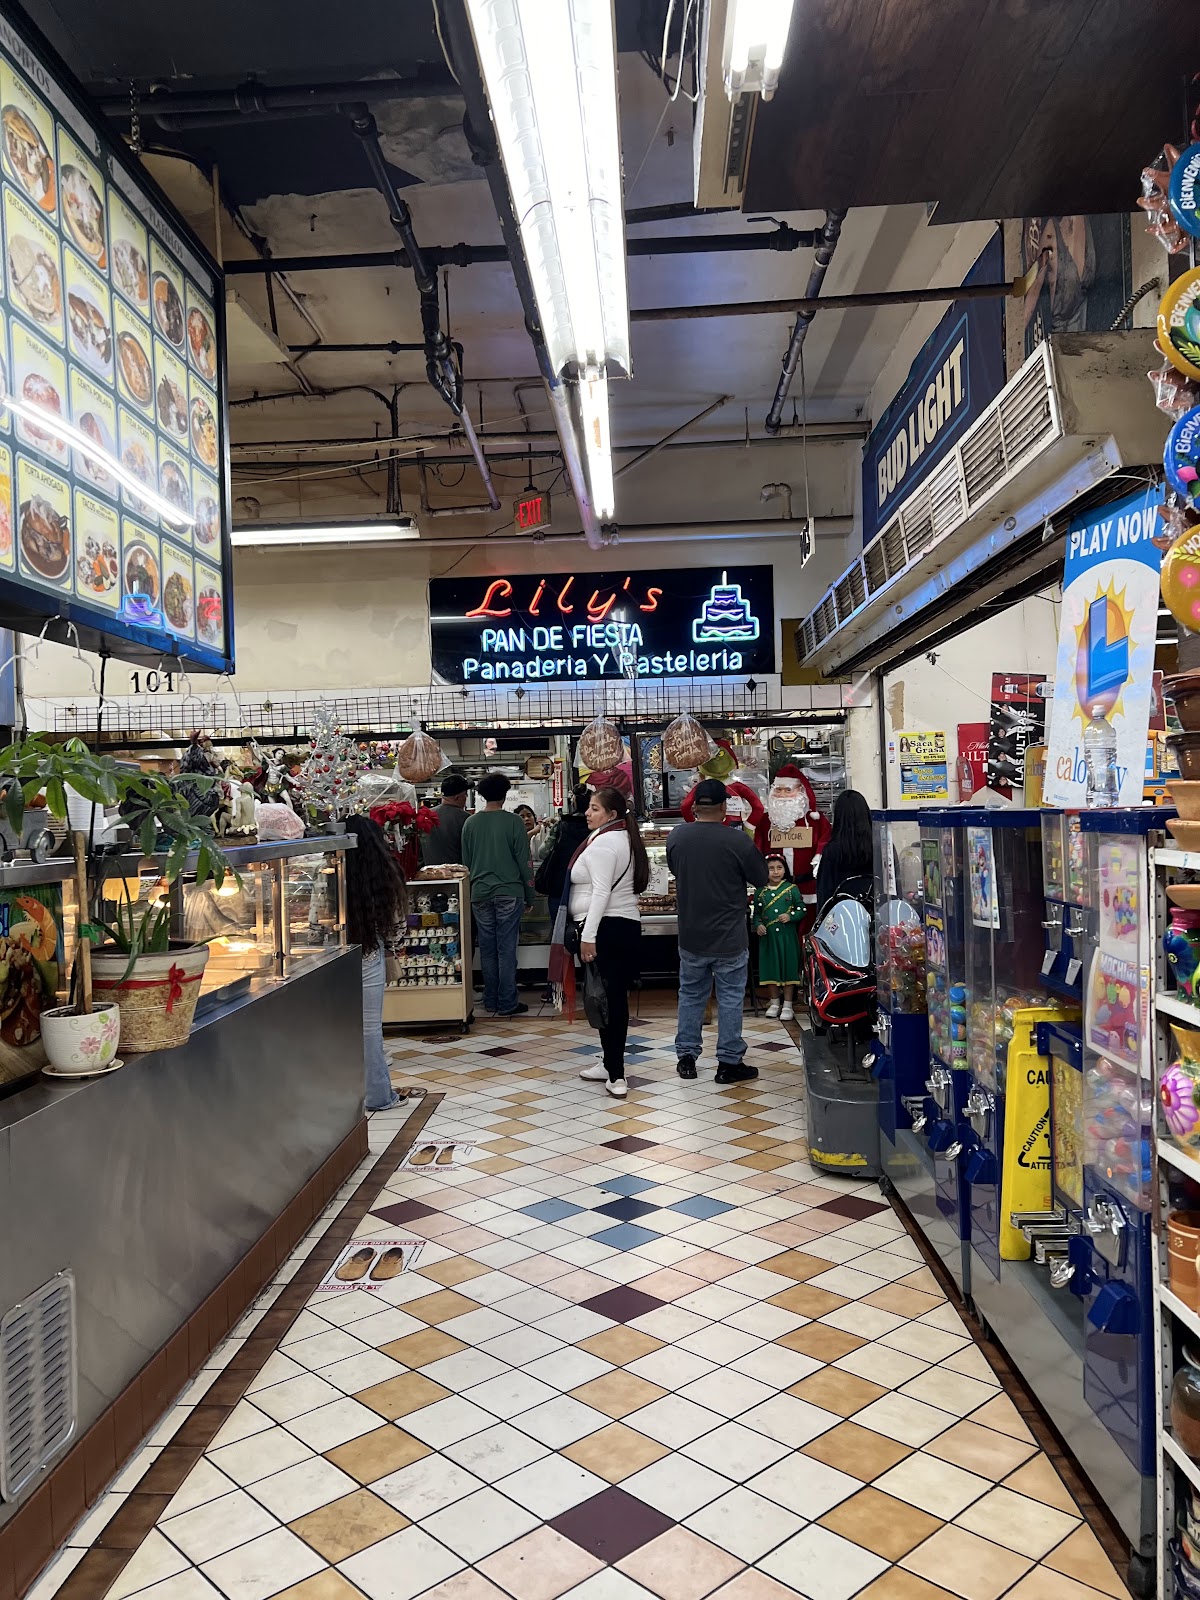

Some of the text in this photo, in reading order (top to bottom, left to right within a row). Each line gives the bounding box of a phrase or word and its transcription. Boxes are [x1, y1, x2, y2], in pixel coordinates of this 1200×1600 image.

[75, 149, 88, 171] SOPES
[8, 192, 38, 228] QUESADILLAS
[149, 207, 183, 259] PLATILLOS
[877, 337, 965, 507] BUD LIGHT
[24, 463, 65, 494] TORTA AHOGADA
[82, 497, 97, 517] TACOS
[519, 497, 542, 528] EXIT
[1070, 505, 1158, 560] PLAY NOW
[465, 576, 663, 623] Lily's
[482, 623, 644, 654] PAN DE FIESTA
[463, 649, 742, 680] Panaderia Y Pasteleria
[131, 671, 174, 693] 101
[910, 740, 933, 748] Saca
[915, 746, 945, 754] Grasa
[961, 751, 989, 762] ULT
[1015, 711, 1027, 782] LAS ULTRAS
[772, 832, 803, 842] NO TOCAR
[1022, 1116, 1048, 1152] CAUTION
